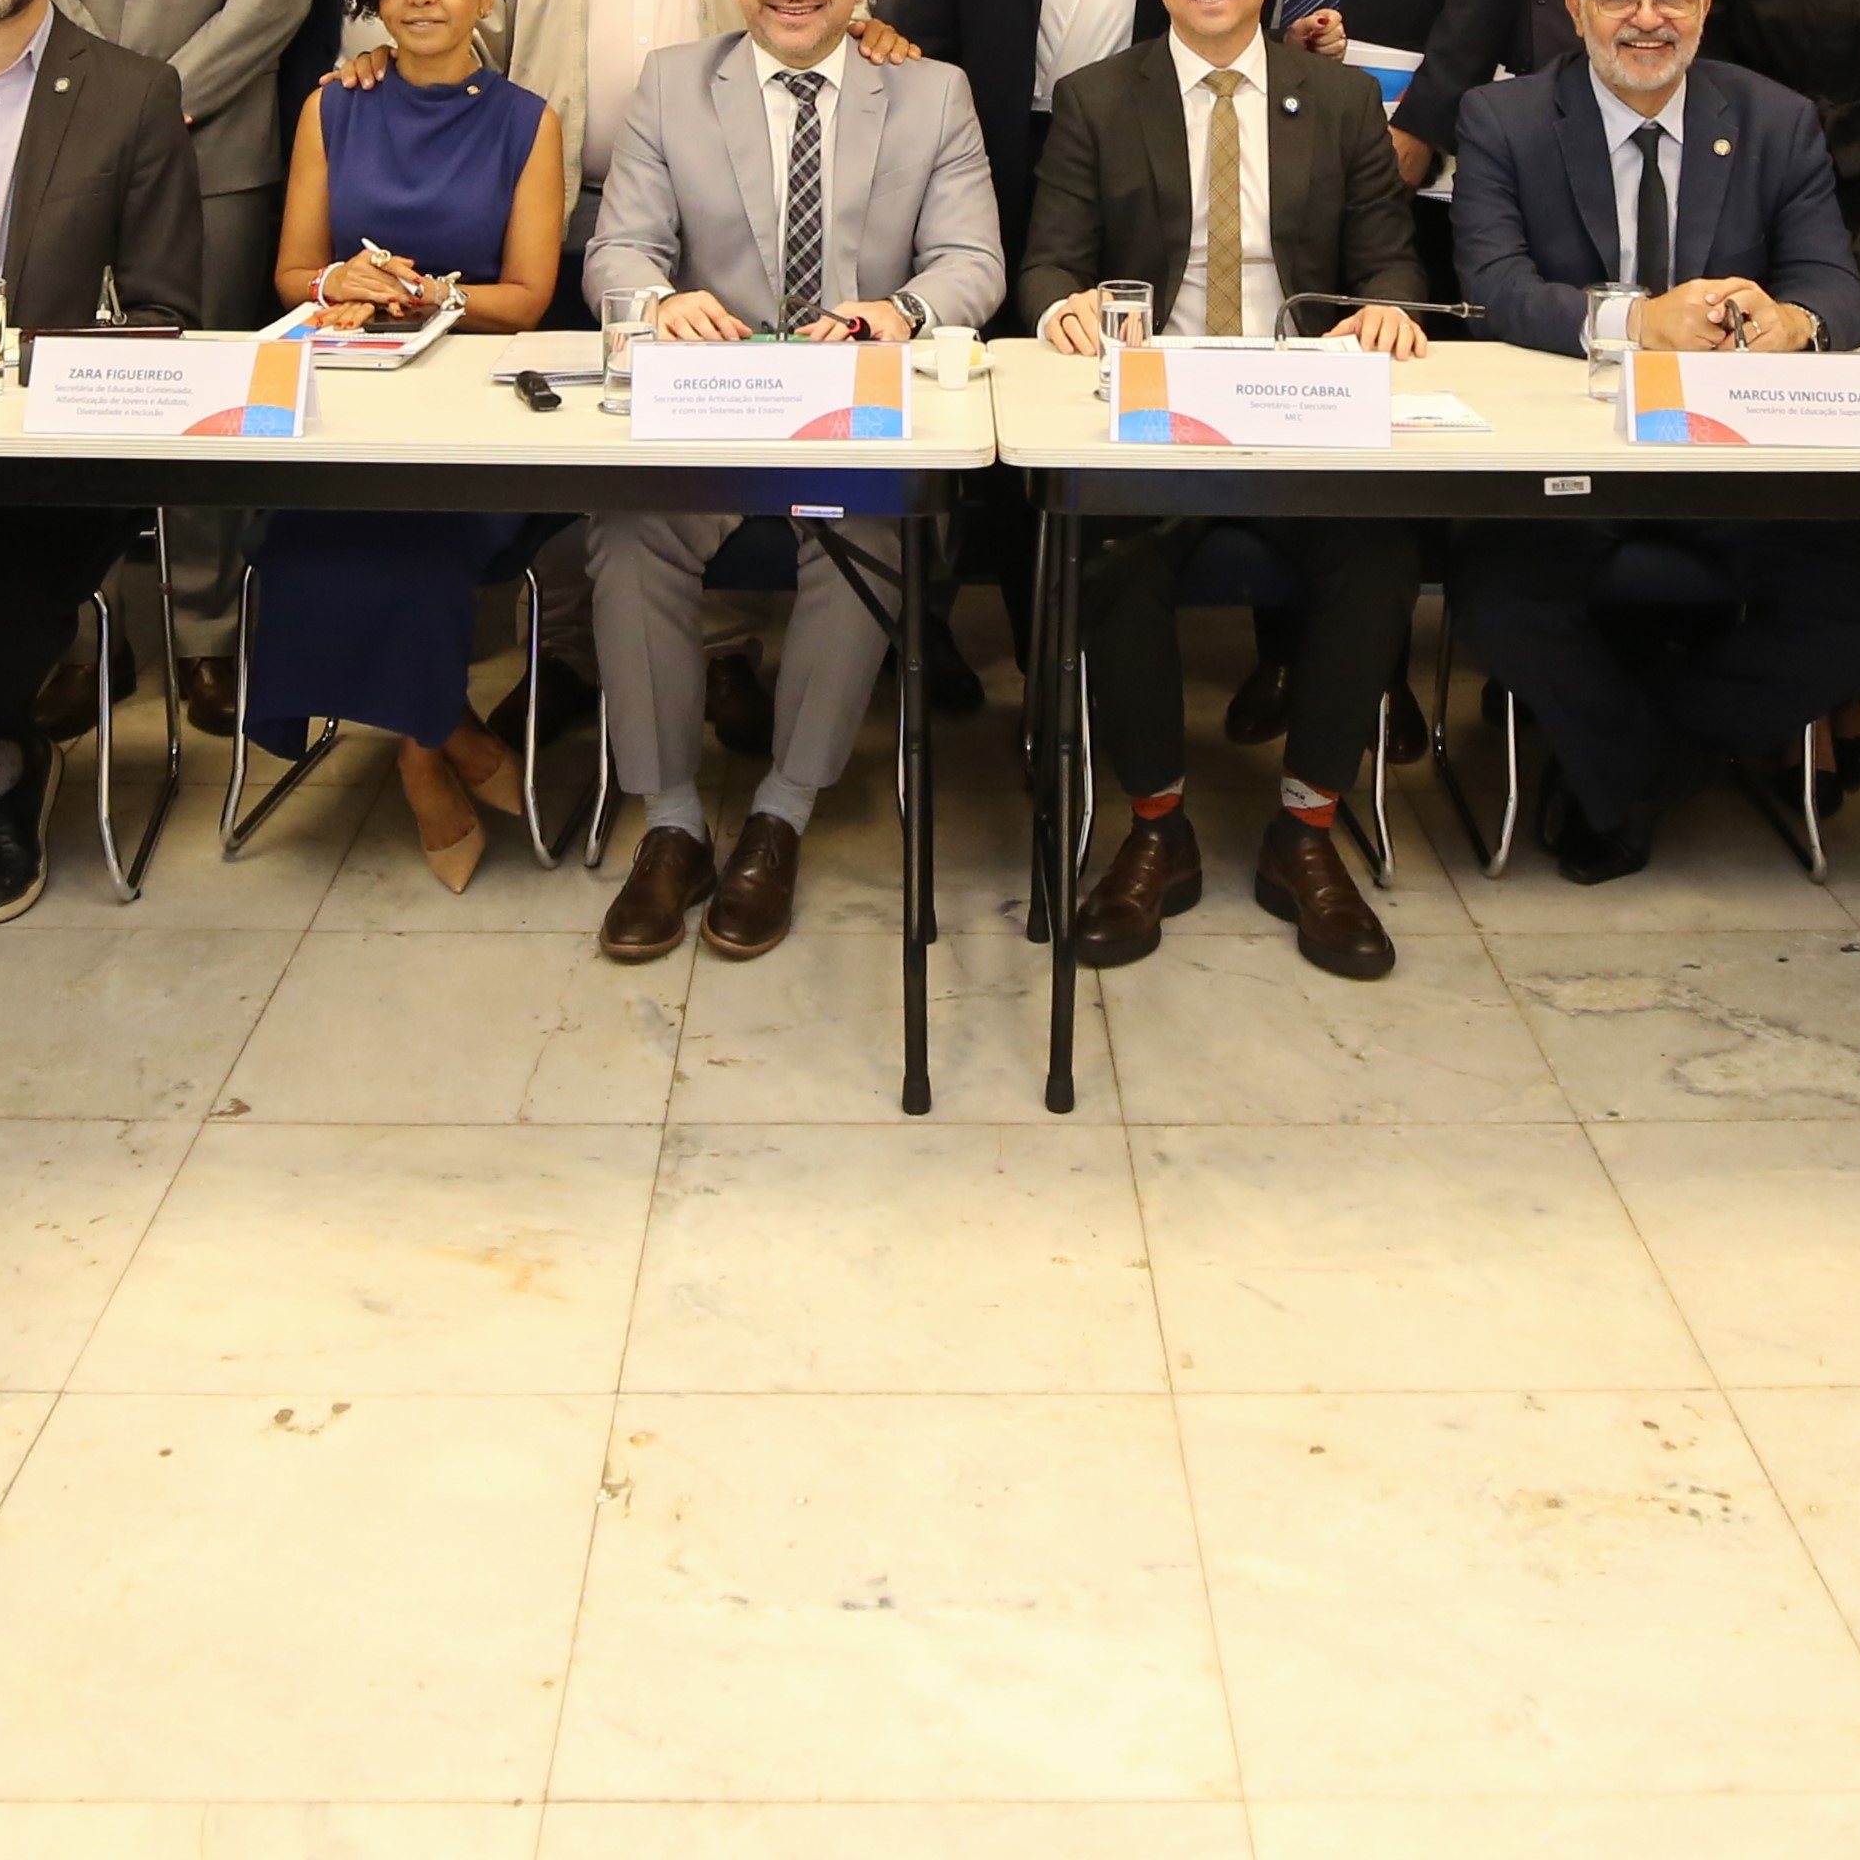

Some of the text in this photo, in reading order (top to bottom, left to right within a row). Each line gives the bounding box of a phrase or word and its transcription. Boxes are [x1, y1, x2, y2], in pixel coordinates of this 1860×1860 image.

[69, 369, 183, 381] ZARA FIGUEIREDO
[673, 376, 783, 389] GREGÓRIO GRISA
[54, 384, 92, 392] Secretária
[108, 385, 144, 394] Educação
[1236, 384, 1351, 397] RODOLFO CABRAL
[56, 396, 108, 404] Alfabetização
[122, 396, 147, 404] Jovens
[708, 395, 752, 404] Articulação
[1729, 390, 1785, 401] MARCUS
[1788, 391, 1844, 402] VINICIUS
[1250, 401, 1290, 409] Secretário
[1299, 402, 1337, 410] Executivo
[76, 407, 121, 415] Diversidade
[131, 408, 164, 416] Inclusão
[1800, 408, 1837, 417] Educação
